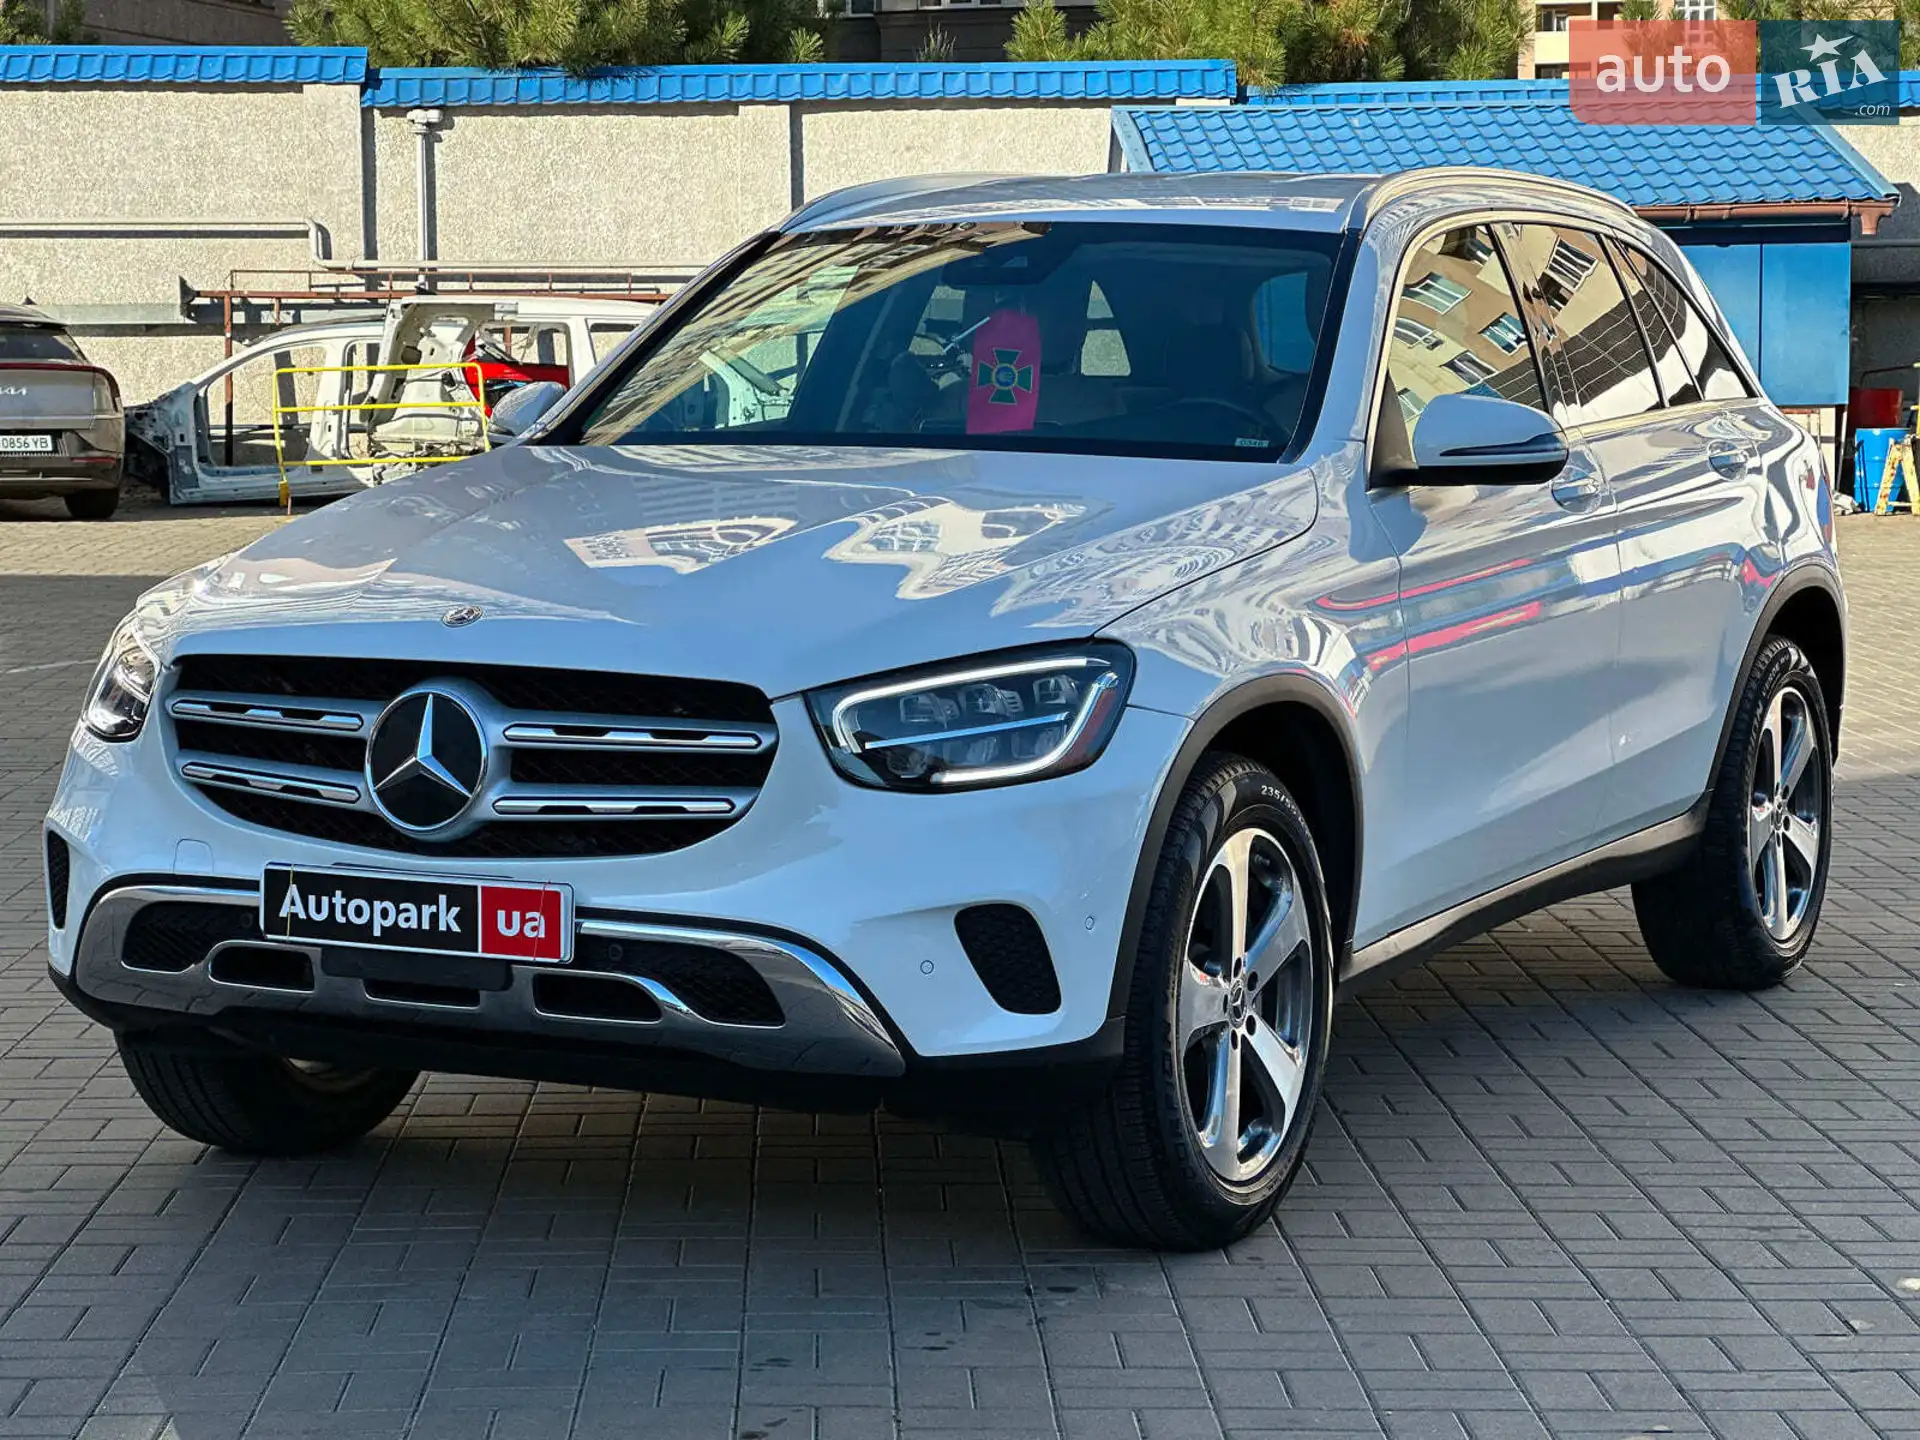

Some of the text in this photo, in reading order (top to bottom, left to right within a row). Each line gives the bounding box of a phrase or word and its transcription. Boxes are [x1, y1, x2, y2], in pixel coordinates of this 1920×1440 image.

[2, 437, 30, 449] 0856
[279, 883, 546, 939] Autopark ua
